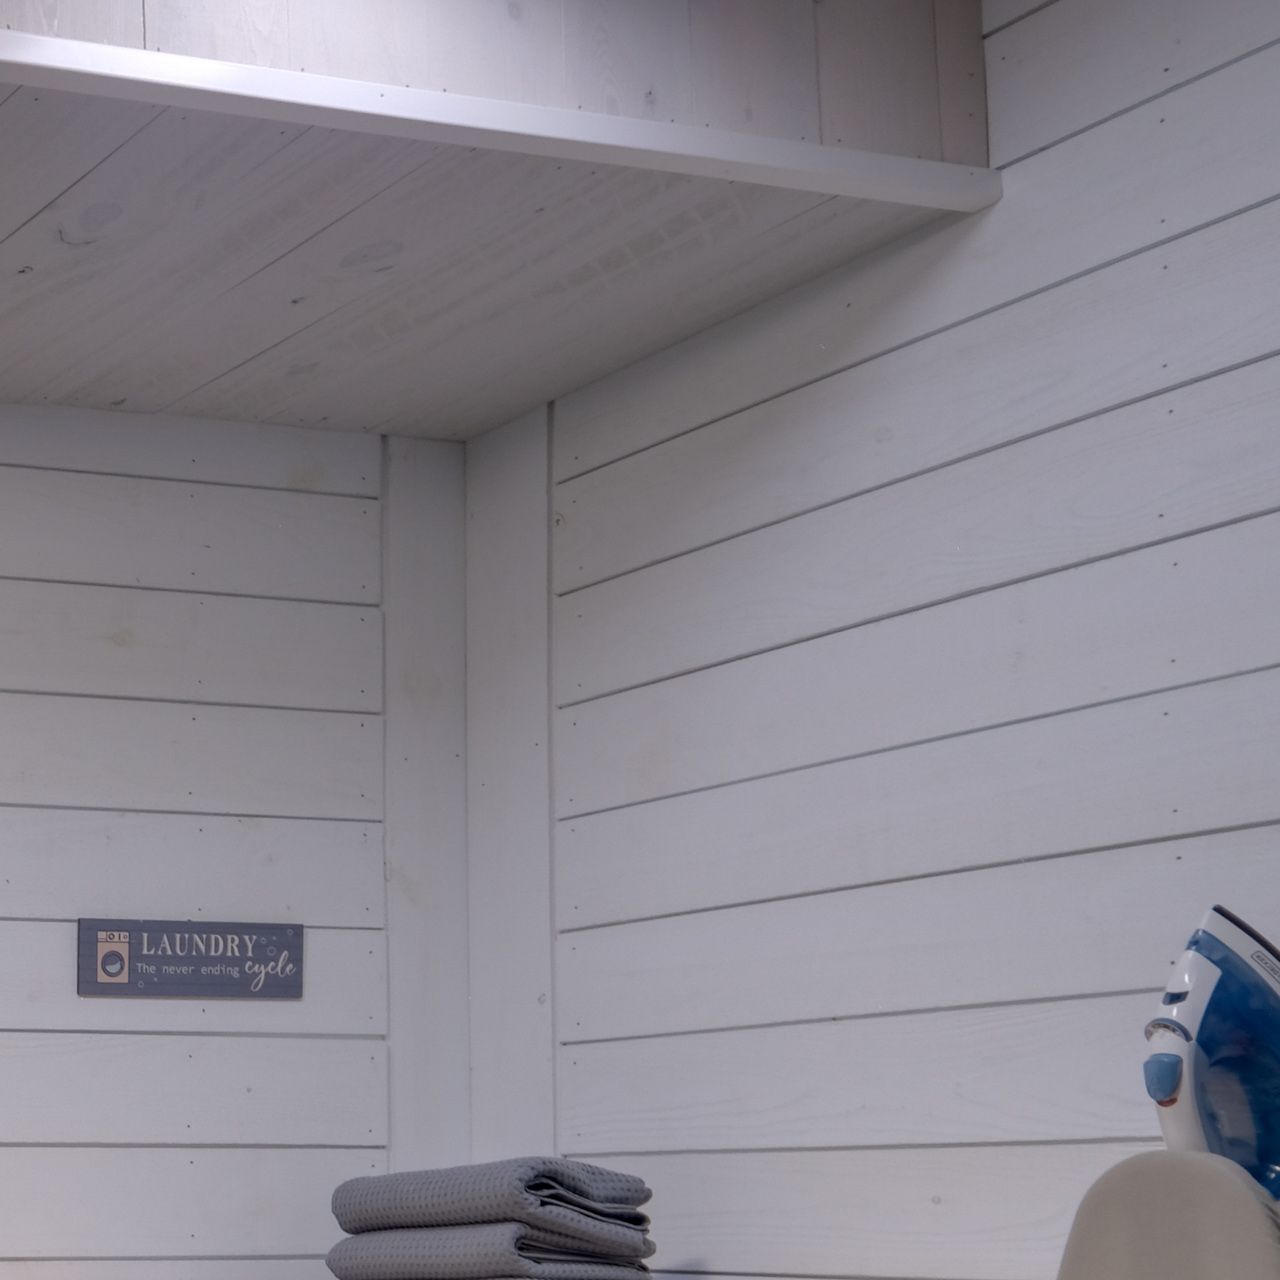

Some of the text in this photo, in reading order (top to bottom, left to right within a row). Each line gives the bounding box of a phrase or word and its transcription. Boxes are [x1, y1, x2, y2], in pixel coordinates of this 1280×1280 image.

[141, 932, 258, 957] LAUNDRY
[136, 950, 297, 992] The never ending cycle
